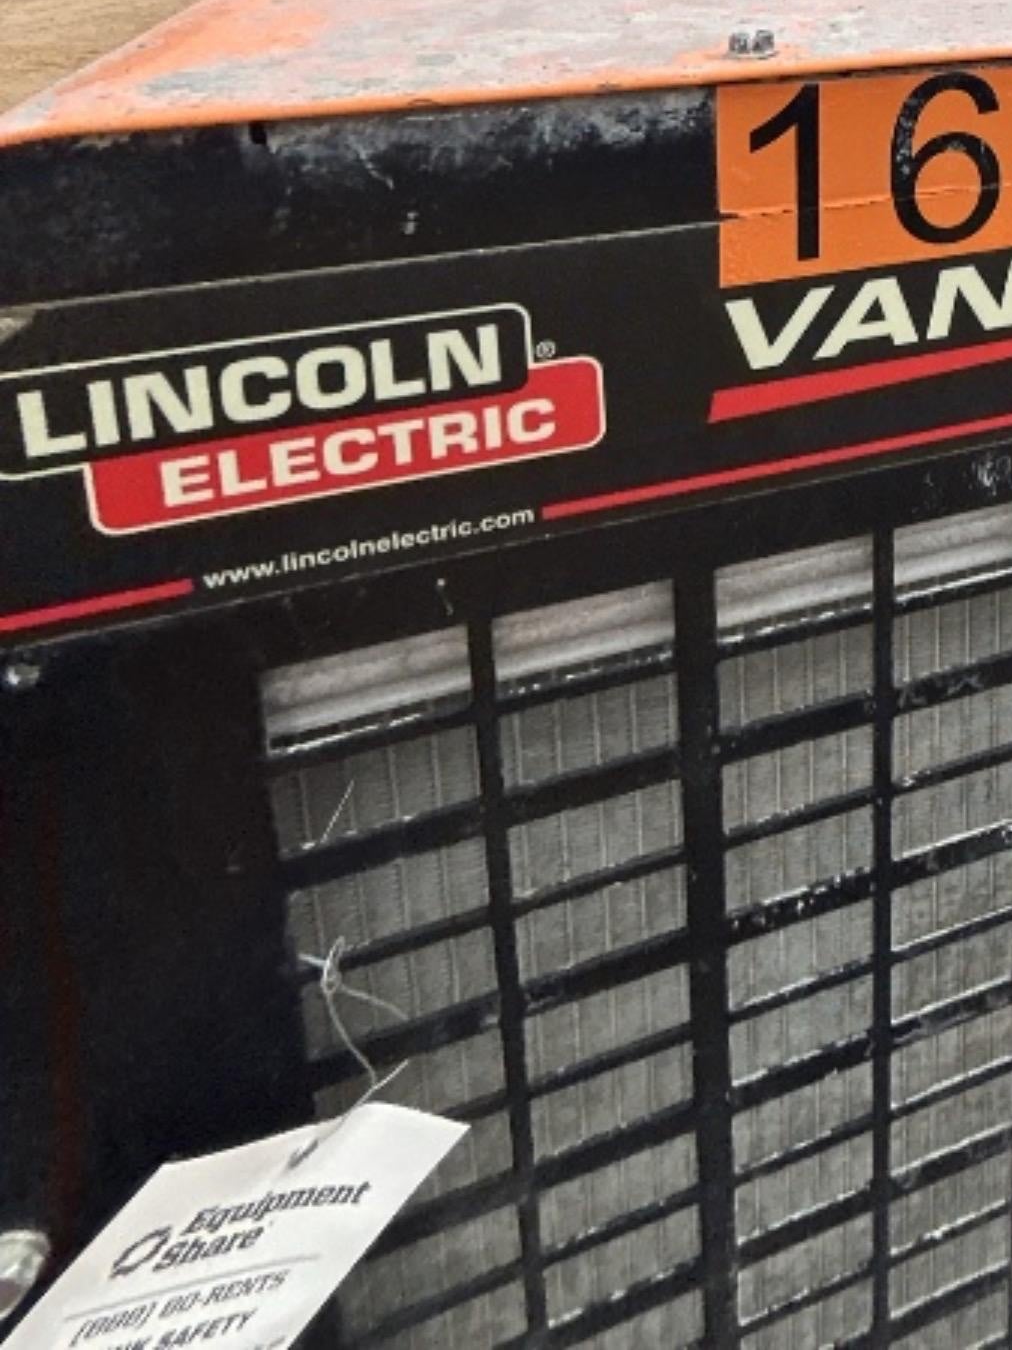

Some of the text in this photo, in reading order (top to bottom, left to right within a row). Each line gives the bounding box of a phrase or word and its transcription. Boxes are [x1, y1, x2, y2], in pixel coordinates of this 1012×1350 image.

[17, 323, 502, 459] LINCOLN
[160, 397, 557, 508] ELECTRIC
[203, 506, 535, 590] www.lincolnelectric.com
[152, 1226, 264, 1273] Share
[180, 1180, 372, 1236] Equipment
